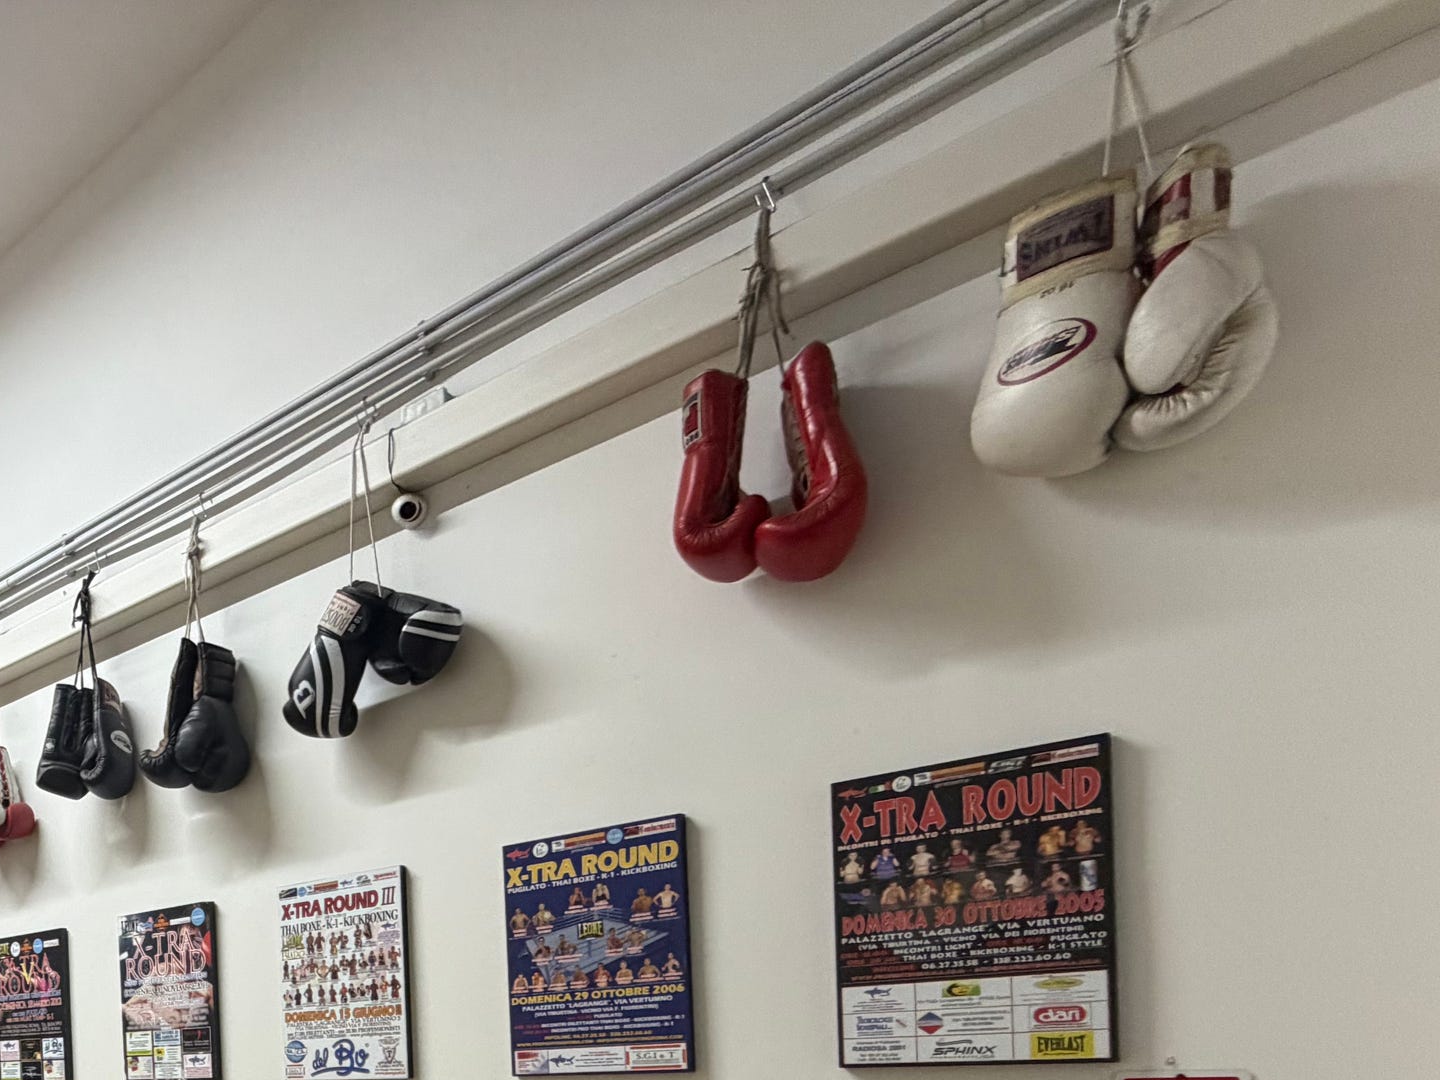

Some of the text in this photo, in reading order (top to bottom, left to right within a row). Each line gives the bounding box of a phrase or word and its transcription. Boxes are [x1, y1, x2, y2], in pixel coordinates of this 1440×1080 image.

[840, 766, 1101, 844] X-TRA ROUND
[507, 840, 679, 888] X-TRA ROUND
[508, 883, 546, 894] PUGILATO
[552, 879, 571, 888] THAI
[573, 875, 595, 884] BOXE
[621, 861, 677, 876] KICKBOXING
[281, 886, 396, 921] X-TRA ROUND III
[842, 888, 1105, 936] DOMENICA 30 OTTOBRE 2005
[281, 909, 399, 937] THAI BOXE K-1 KICKBOXING
[842, 931, 913, 944] PALAZZETTO
[998, 922, 1020, 930] VIA
[1027, 914, 1105, 927] VERTUMNO
[133, 928, 196, 959] X-TRA
[893, 945, 940, 955] INCONTRI
[970, 946, 1035, 956] KICKBOXING
[1070, 940, 1102, 948] STYLE
[125, 949, 206, 980] ROUND
[512, 983, 685, 1005] DOMENICA 29 OTTOBRE 2006
[932, 1045, 998, 1056] SPHINX
[1037, 1035, 1086, 1053] EVERLAST
